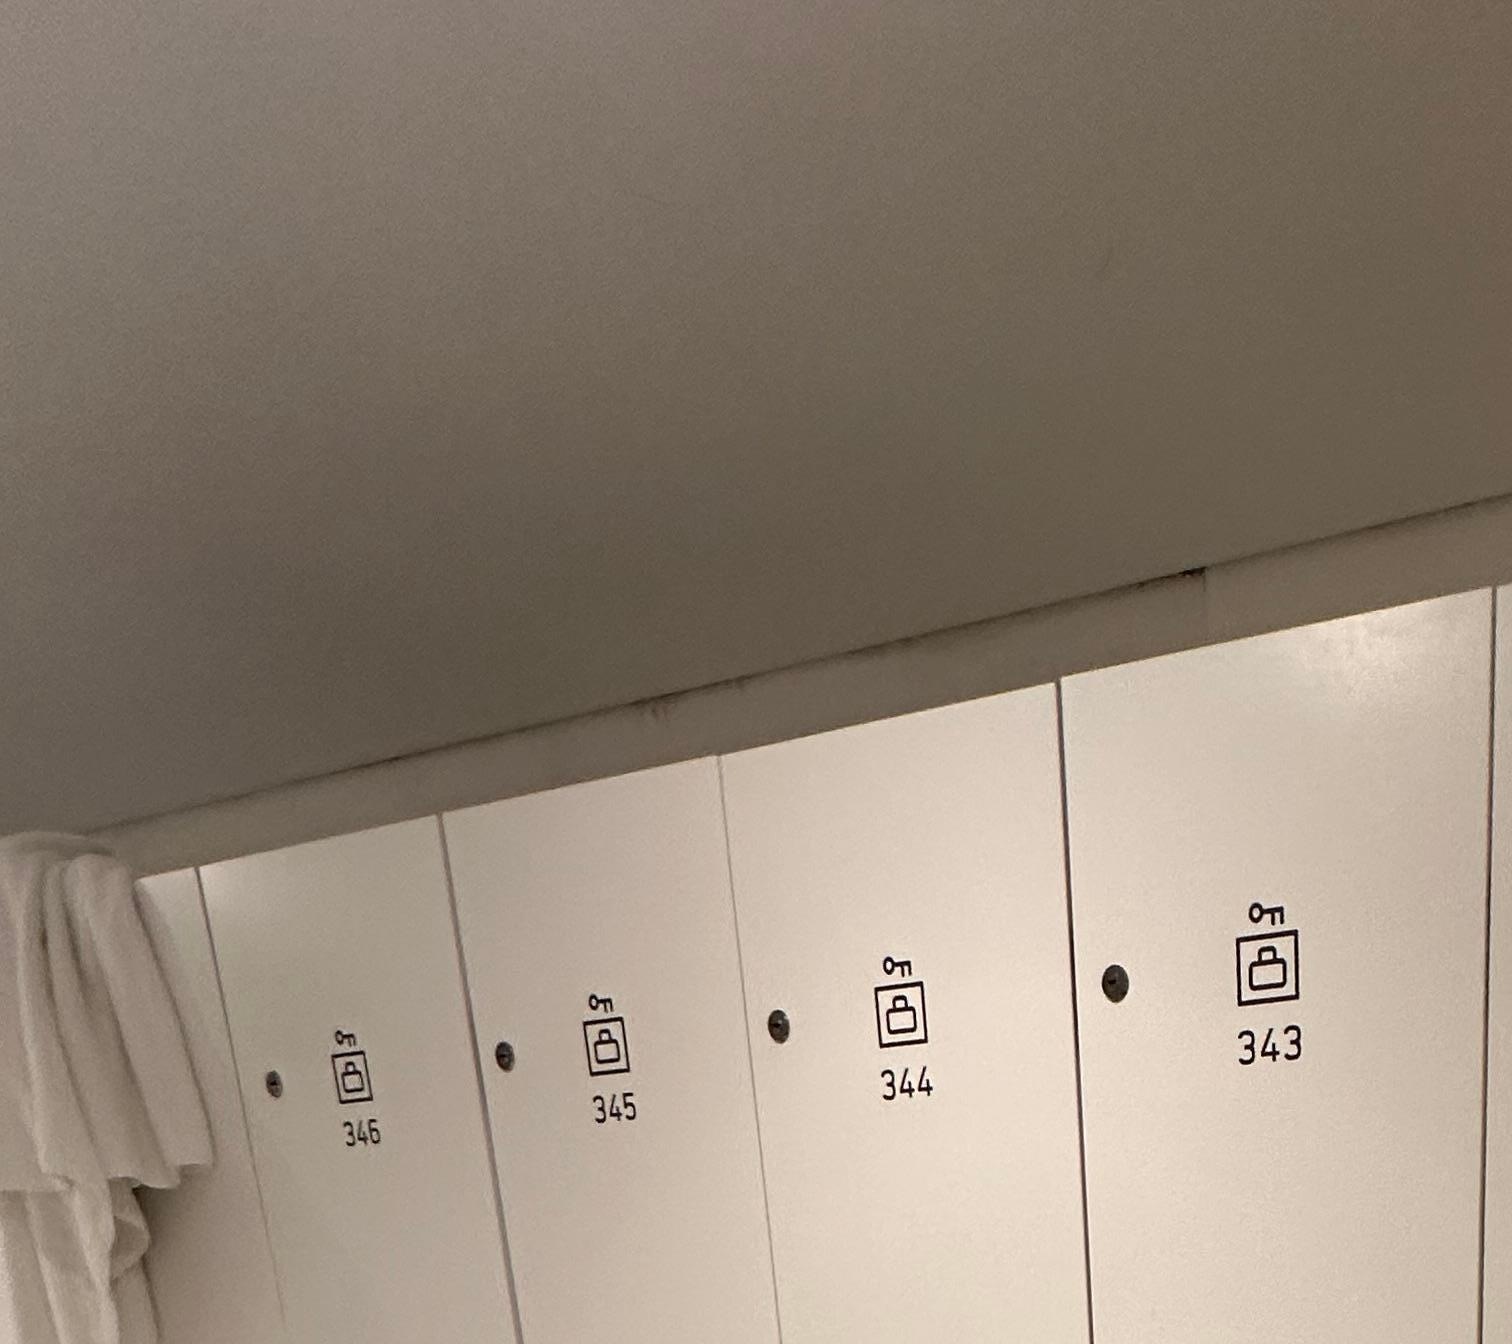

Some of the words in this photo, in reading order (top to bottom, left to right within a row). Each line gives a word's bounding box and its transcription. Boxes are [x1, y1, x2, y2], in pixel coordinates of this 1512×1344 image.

[1237, 1025, 1303, 1066] 343
[880, 1065, 935, 1102] 344
[592, 1092, 638, 1124] 345
[342, 1118, 382, 1147] 346
